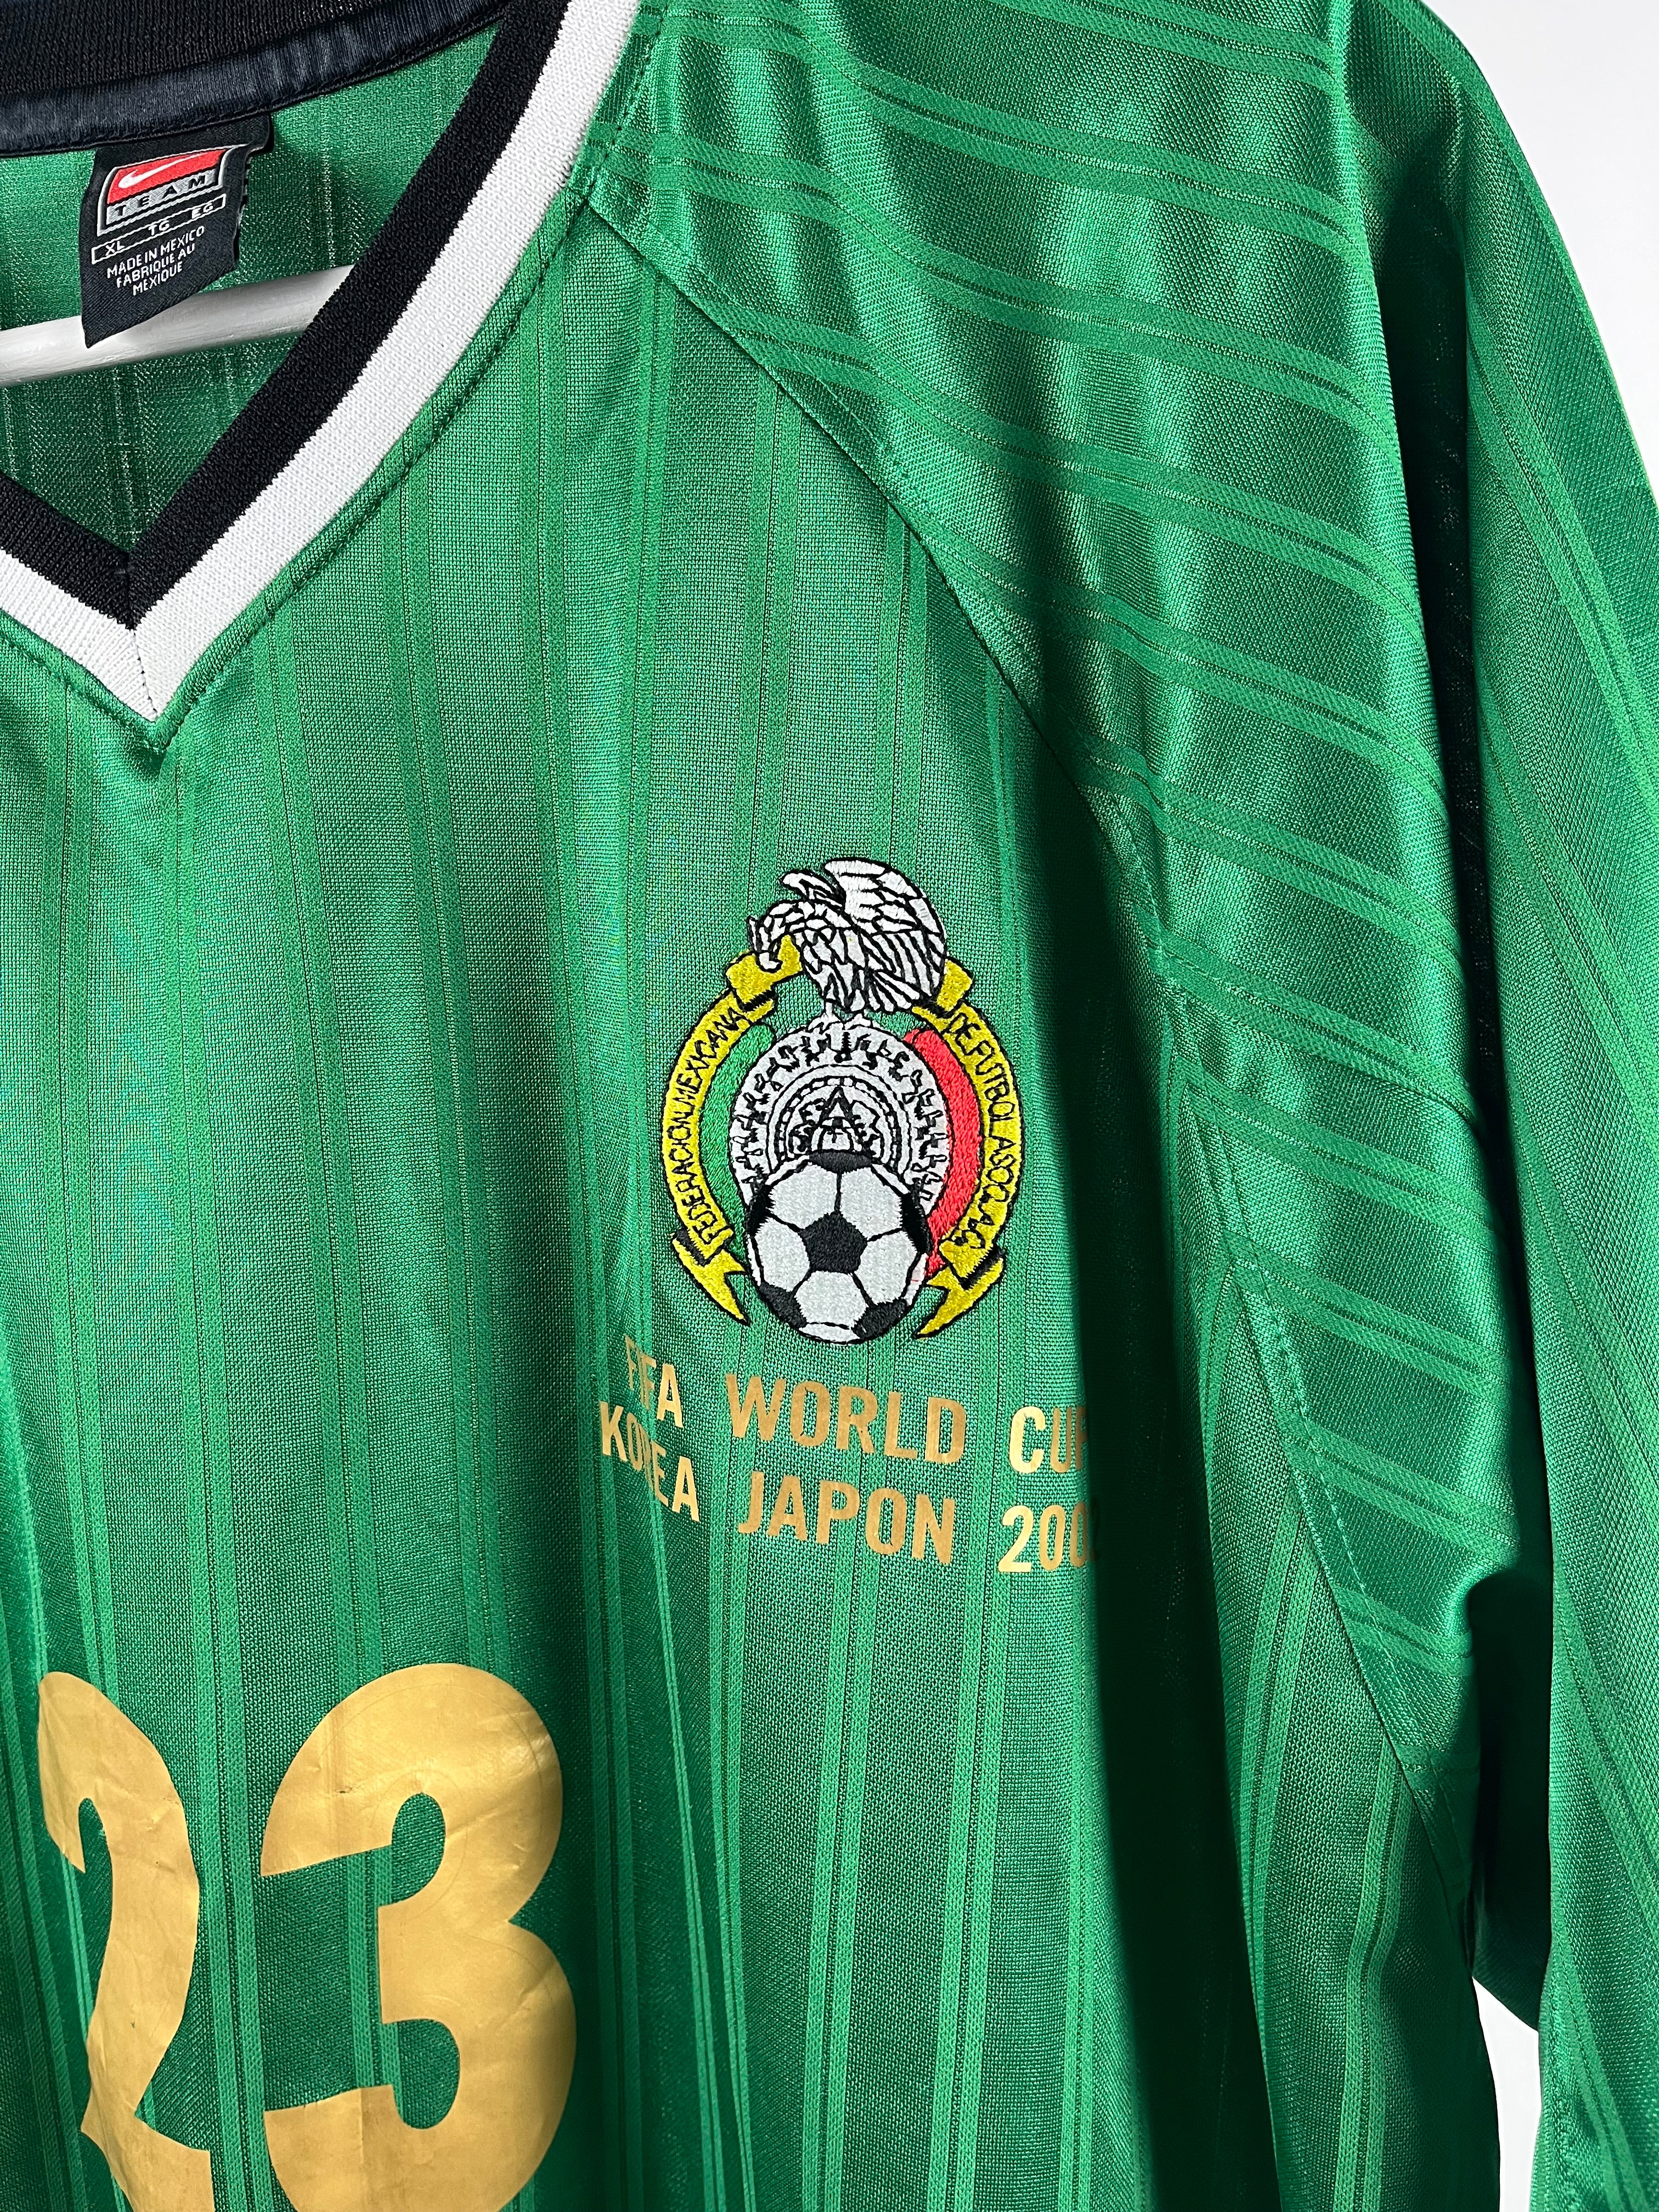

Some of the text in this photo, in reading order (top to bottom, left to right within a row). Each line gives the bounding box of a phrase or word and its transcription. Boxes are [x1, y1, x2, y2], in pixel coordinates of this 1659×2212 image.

[116, 174, 207, 216] TEAM
[105, 203, 213, 256] XL TG EG
[107, 225, 205, 278] MADE IN MEXICO
[116, 244, 195, 288] FABRIQUE AU
[133, 261, 183, 296] MEXIQUE
[673, 1007, 753, 1107] MEXICANA
[624, 1334, 684, 1428] FIFA
[725, 1373, 967, 1464] WORLD
[600, 1401, 700, 1522] KOREA
[738, 1471, 956, 1564] JAPON
[38, 1663, 577, 2212] 23
